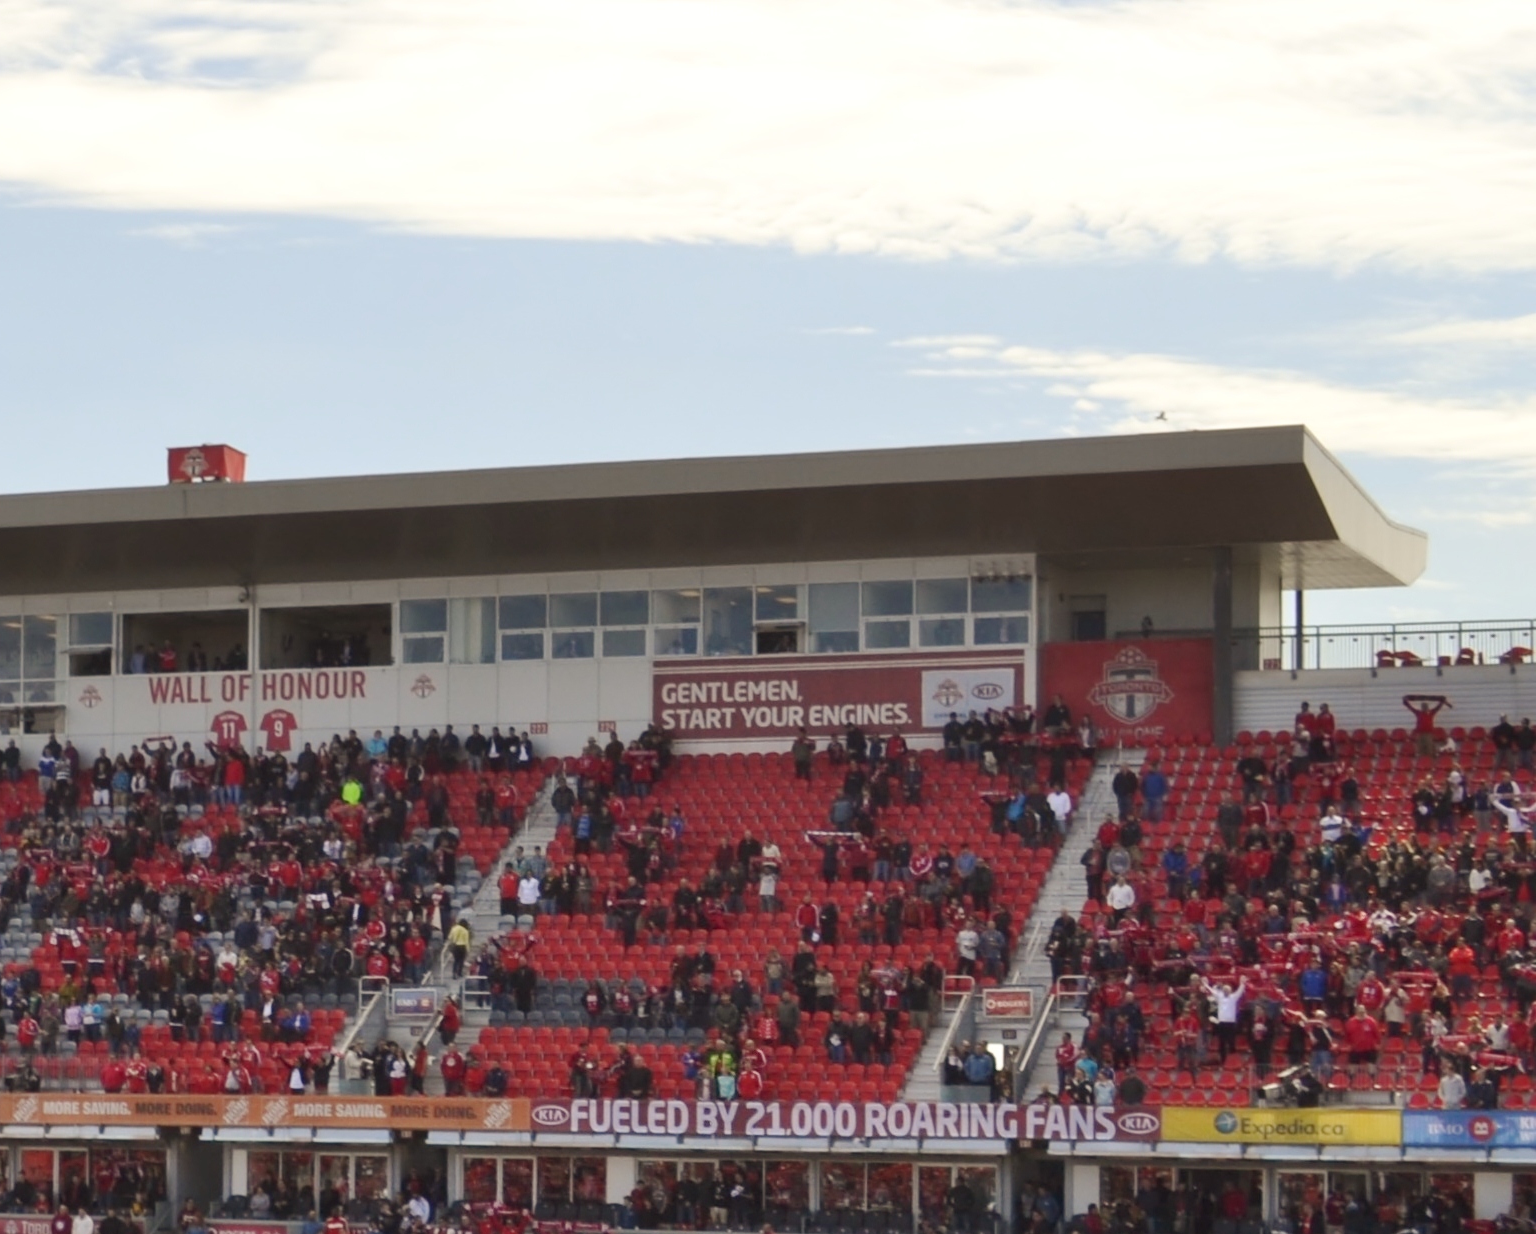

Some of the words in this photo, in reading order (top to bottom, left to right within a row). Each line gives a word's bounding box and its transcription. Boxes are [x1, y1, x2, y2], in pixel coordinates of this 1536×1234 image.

[149, 676, 212, 703] WALL
[222, 675, 251, 701] OF
[262, 671, 366, 700] HONOUR
[662, 680, 803, 704] GENTLEMEN,
[662, 708, 738, 730] START
[742, 706, 804, 727] YOUR
[809, 703, 912, 726] ENGINES.
[222, 721, 235, 740] 11
[275, 720, 284, 738] 9
[43, 1101, 79, 1115] MORE
[83, 1102, 132, 1116] SAVING.
[135, 1103, 171, 1116] MORE
[294, 1104, 332, 1117] MORE
[336, 1105, 387, 1118] SAVING.
[390, 1106, 429, 1118] MORE
[538, 1109, 566, 1121] KIA
[570, 1100, 689, 1133] FUELED
[696, 1102, 737, 1135] BY
[864, 1104, 1017, 1138] ROARING
[1026, 1106, 1116, 1140] FANS
[1122, 1117, 1158, 1131] KIA
[1240, 1117, 1344, 1140] Expedia.ca
[1429, 1122, 1464, 1135] BMO
